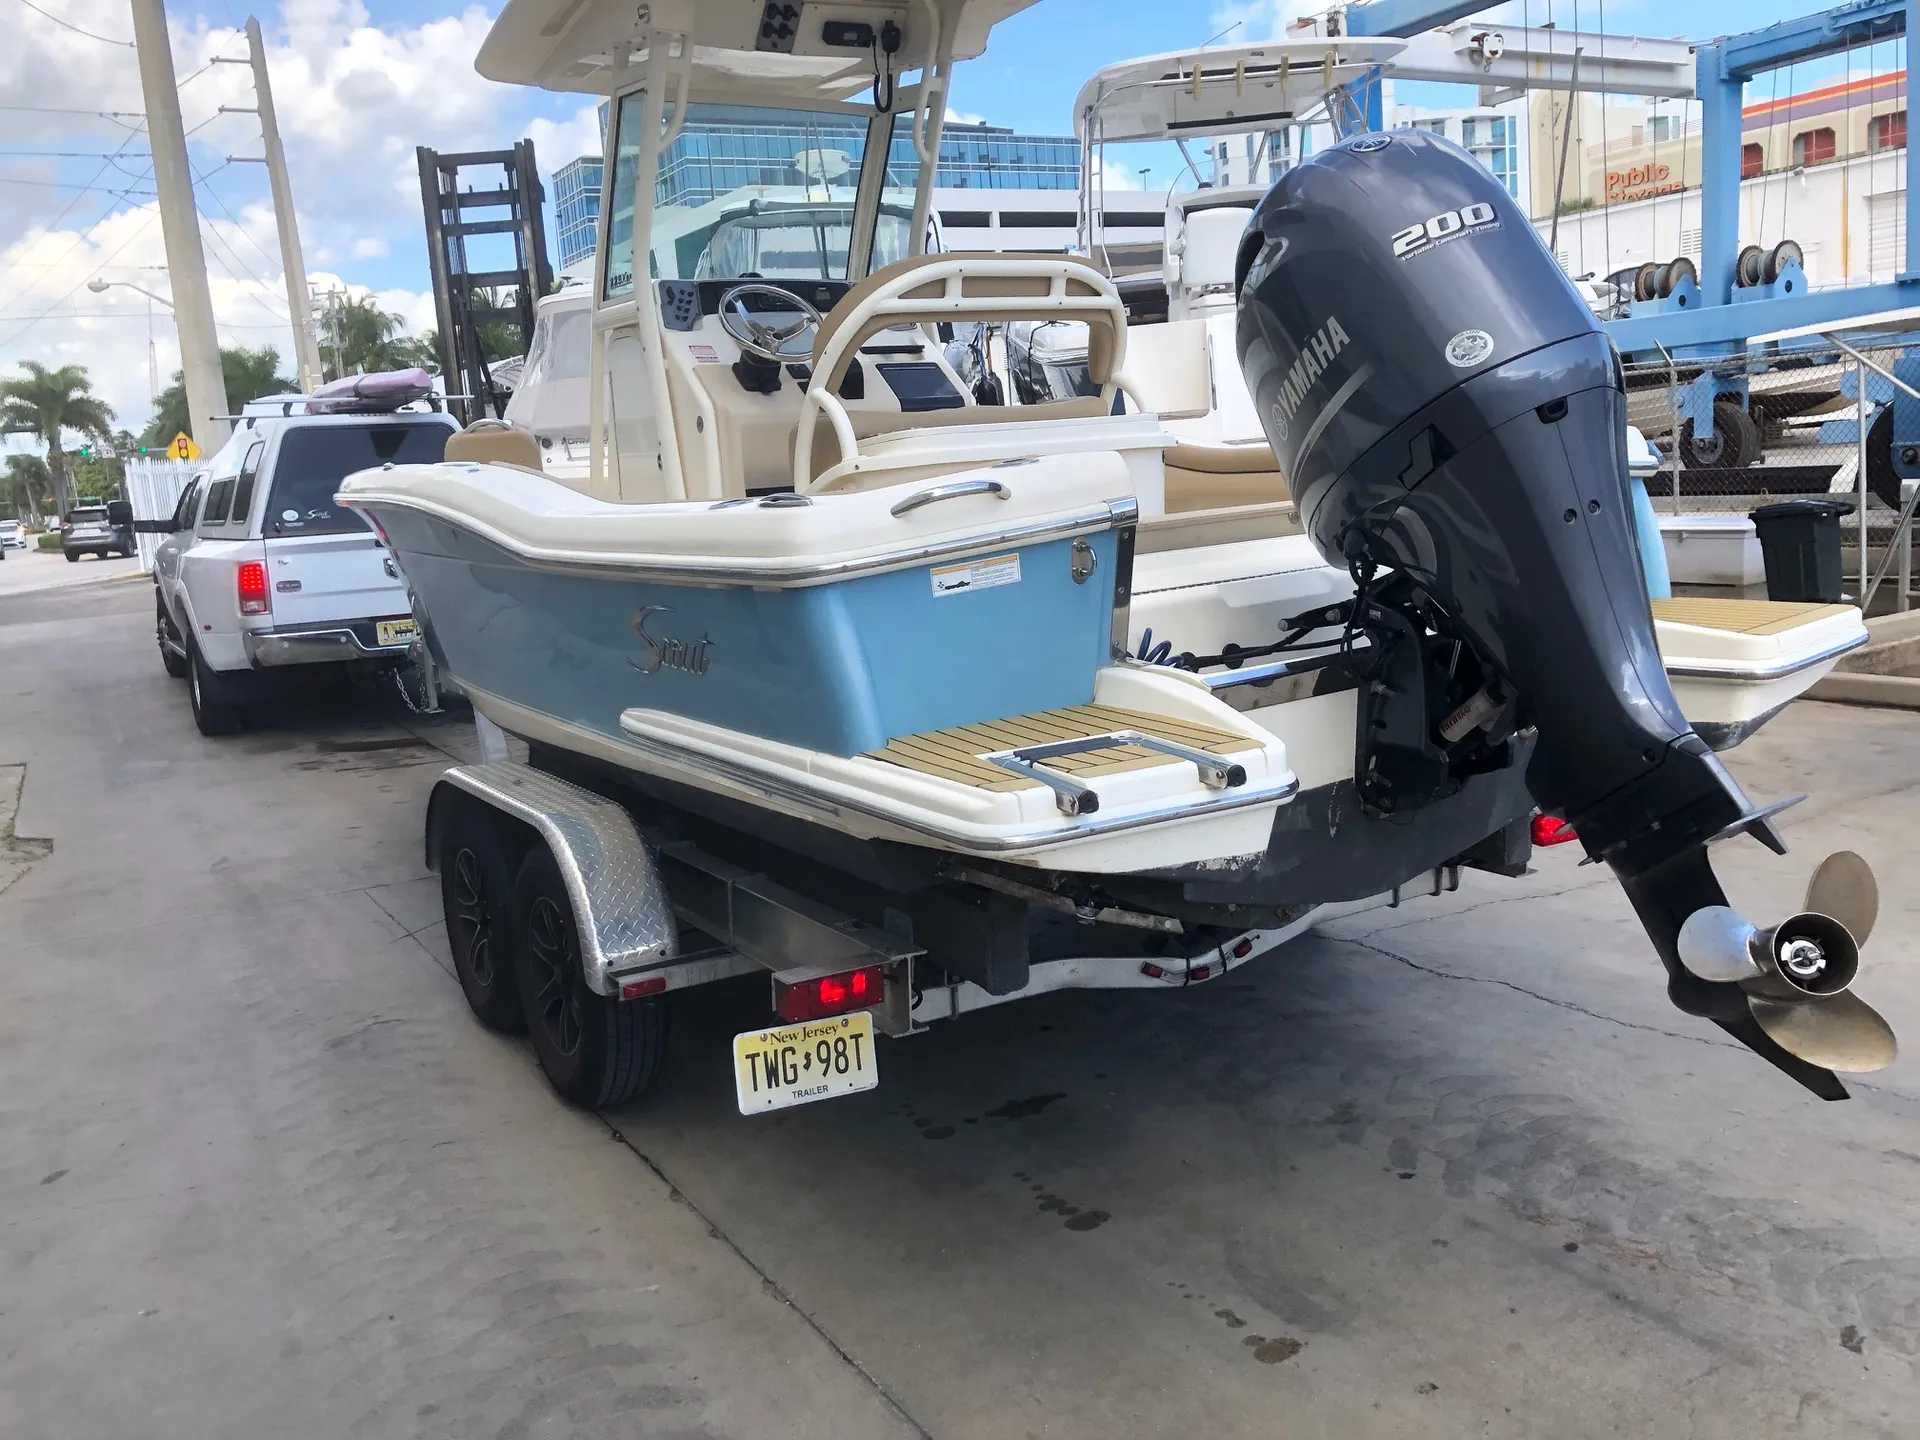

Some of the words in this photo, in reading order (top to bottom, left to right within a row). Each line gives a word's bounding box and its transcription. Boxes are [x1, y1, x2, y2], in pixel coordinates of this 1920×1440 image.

[1606, 163, 1669, 191] Public
[1391, 202, 1495, 257] 200
[1402, 243, 1434, 261] Variable
[1436, 229, 1473, 246] Camshaft
[1476, 222, 1501, 234] Timing
[1277, 315, 1351, 421] YAMAHA
[625, 603, 716, 676] Scout
[769, 1031, 800, 1046] New
[801, 1024, 839, 1042] Jersey
[745, 1046, 798, 1092] TWG
[816, 1033, 864, 1078] 98T
[792, 1084, 829, 1099] TRAILER
